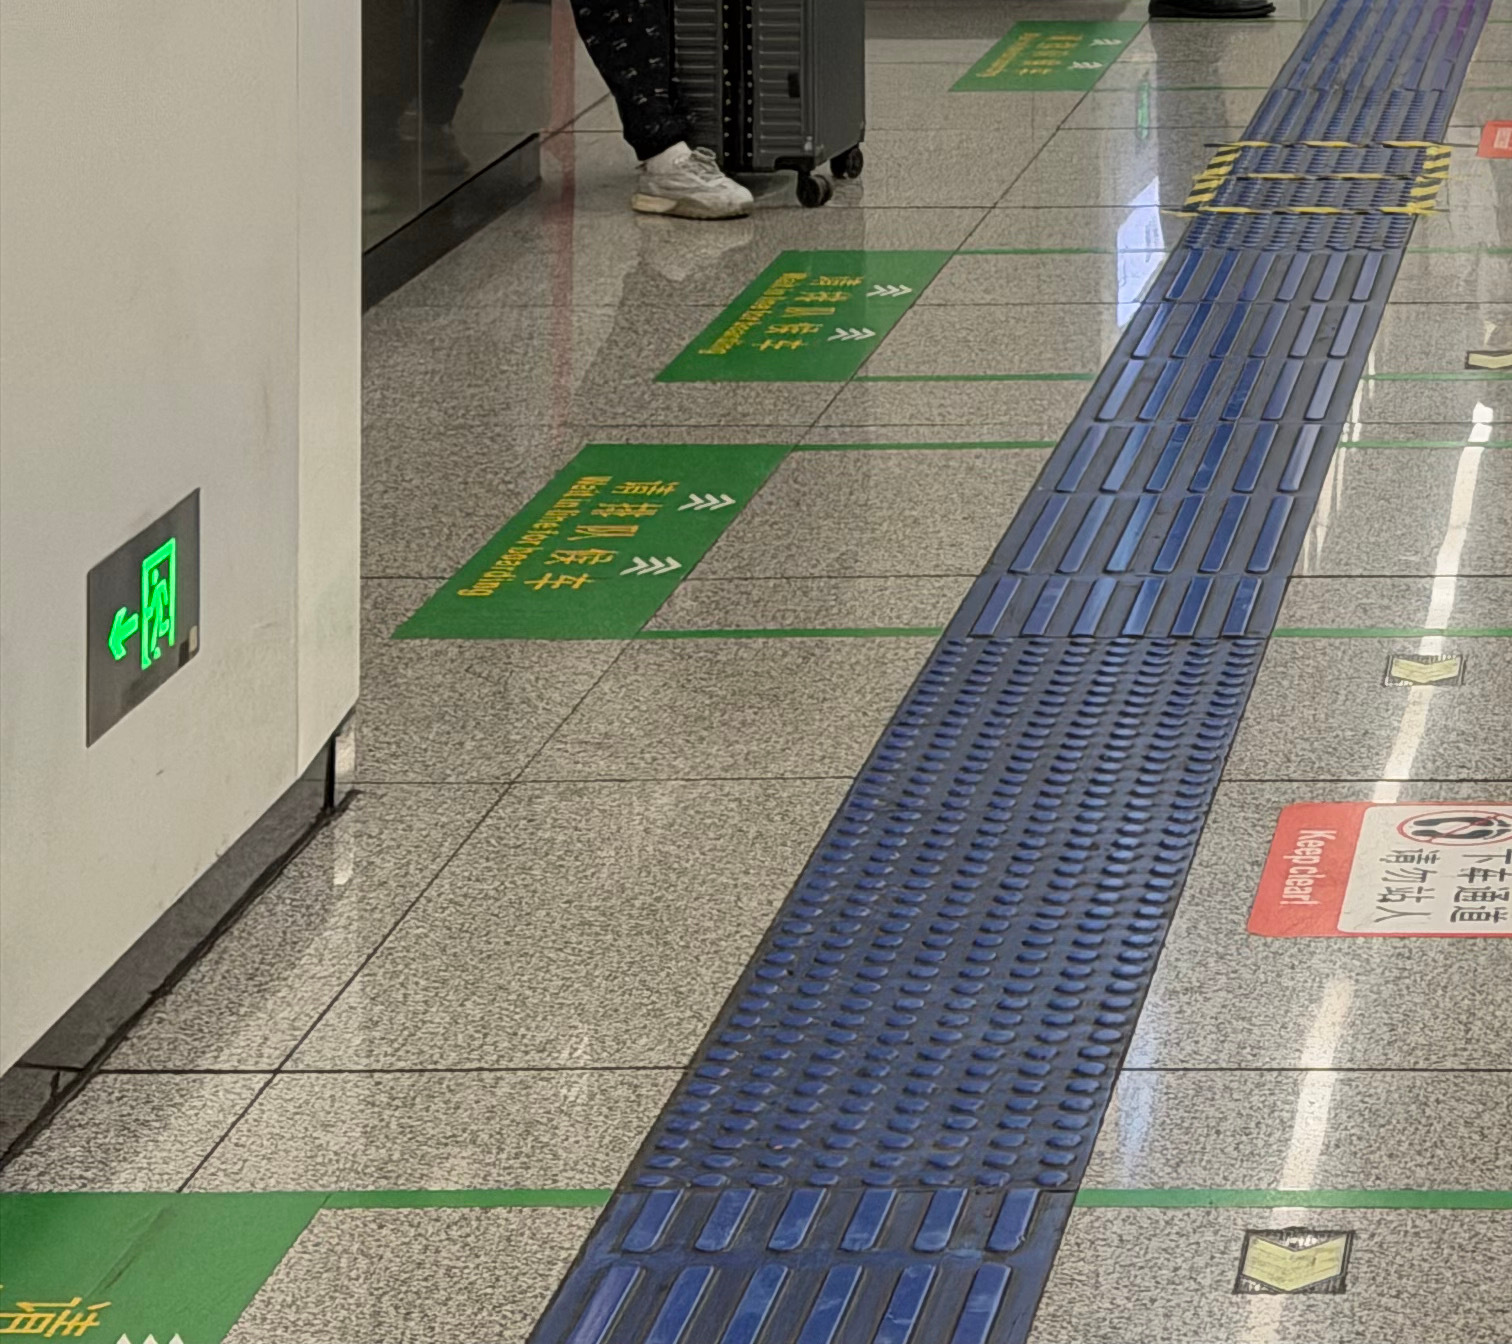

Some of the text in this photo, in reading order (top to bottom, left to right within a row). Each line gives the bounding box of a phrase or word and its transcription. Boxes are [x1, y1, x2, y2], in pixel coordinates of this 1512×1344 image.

[562, 474, 614, 497] Wait
[523, 479, 681, 593] 请排队候车
[533, 508, 577, 530] line
[457, 546, 544, 599] boarding
[1279, 828, 1338, 907] Keep clear!
[1373, 848, 1441, 925] 请勿站人
